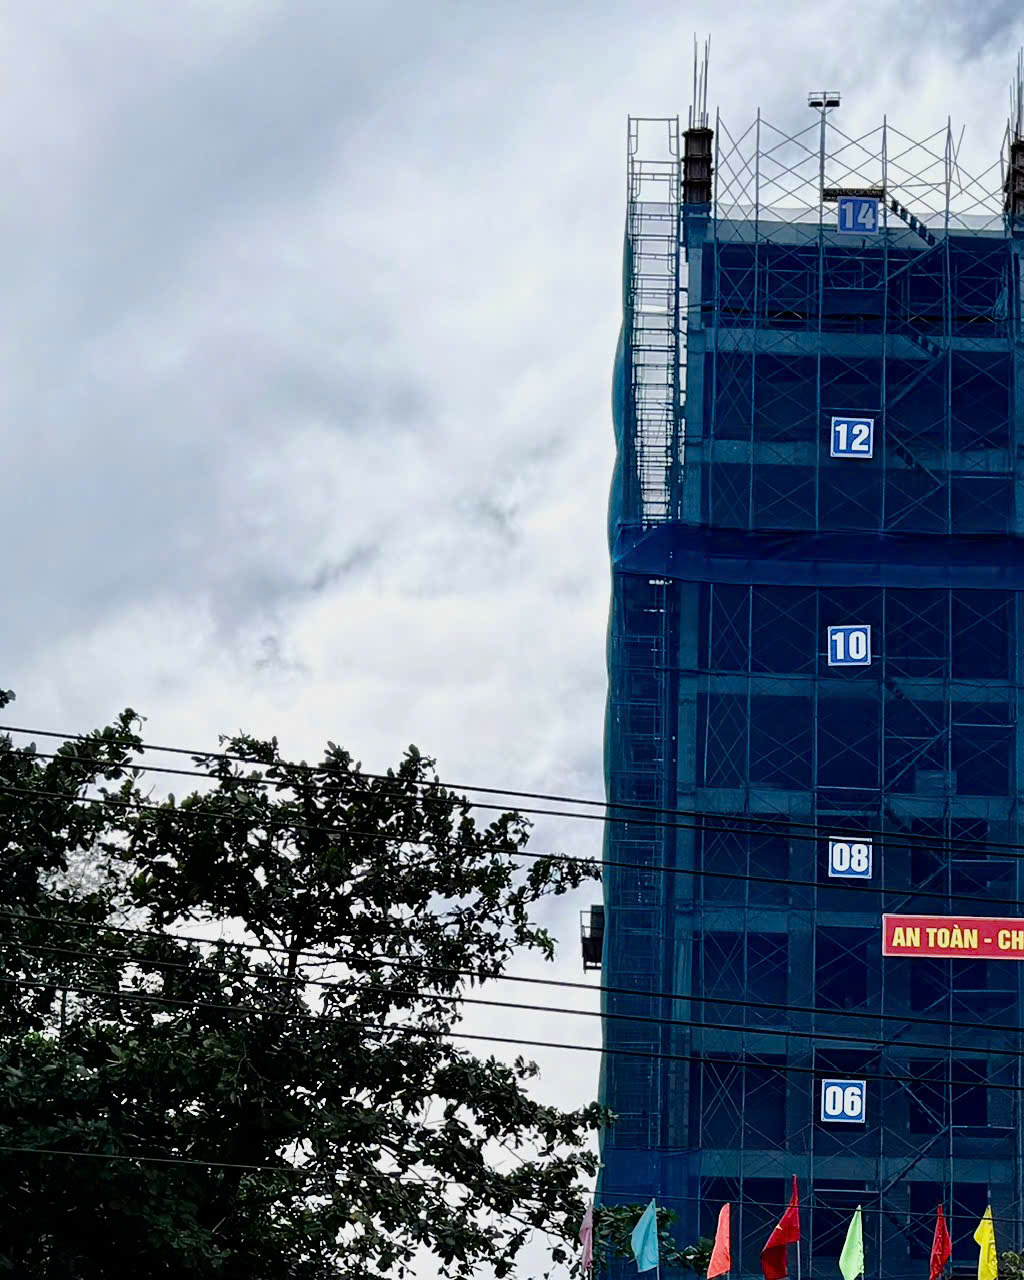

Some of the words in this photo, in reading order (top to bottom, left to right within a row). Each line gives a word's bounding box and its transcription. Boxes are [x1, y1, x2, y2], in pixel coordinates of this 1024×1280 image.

[842, 202, 875, 230] 14
[835, 423, 870, 451] 12
[831, 631, 866, 660] 10
[832, 842, 869, 872] 08
[892, 927, 920, 946] AN
[926, 923, 977, 948] TOÀN
[825, 1085, 862, 1117] 06
